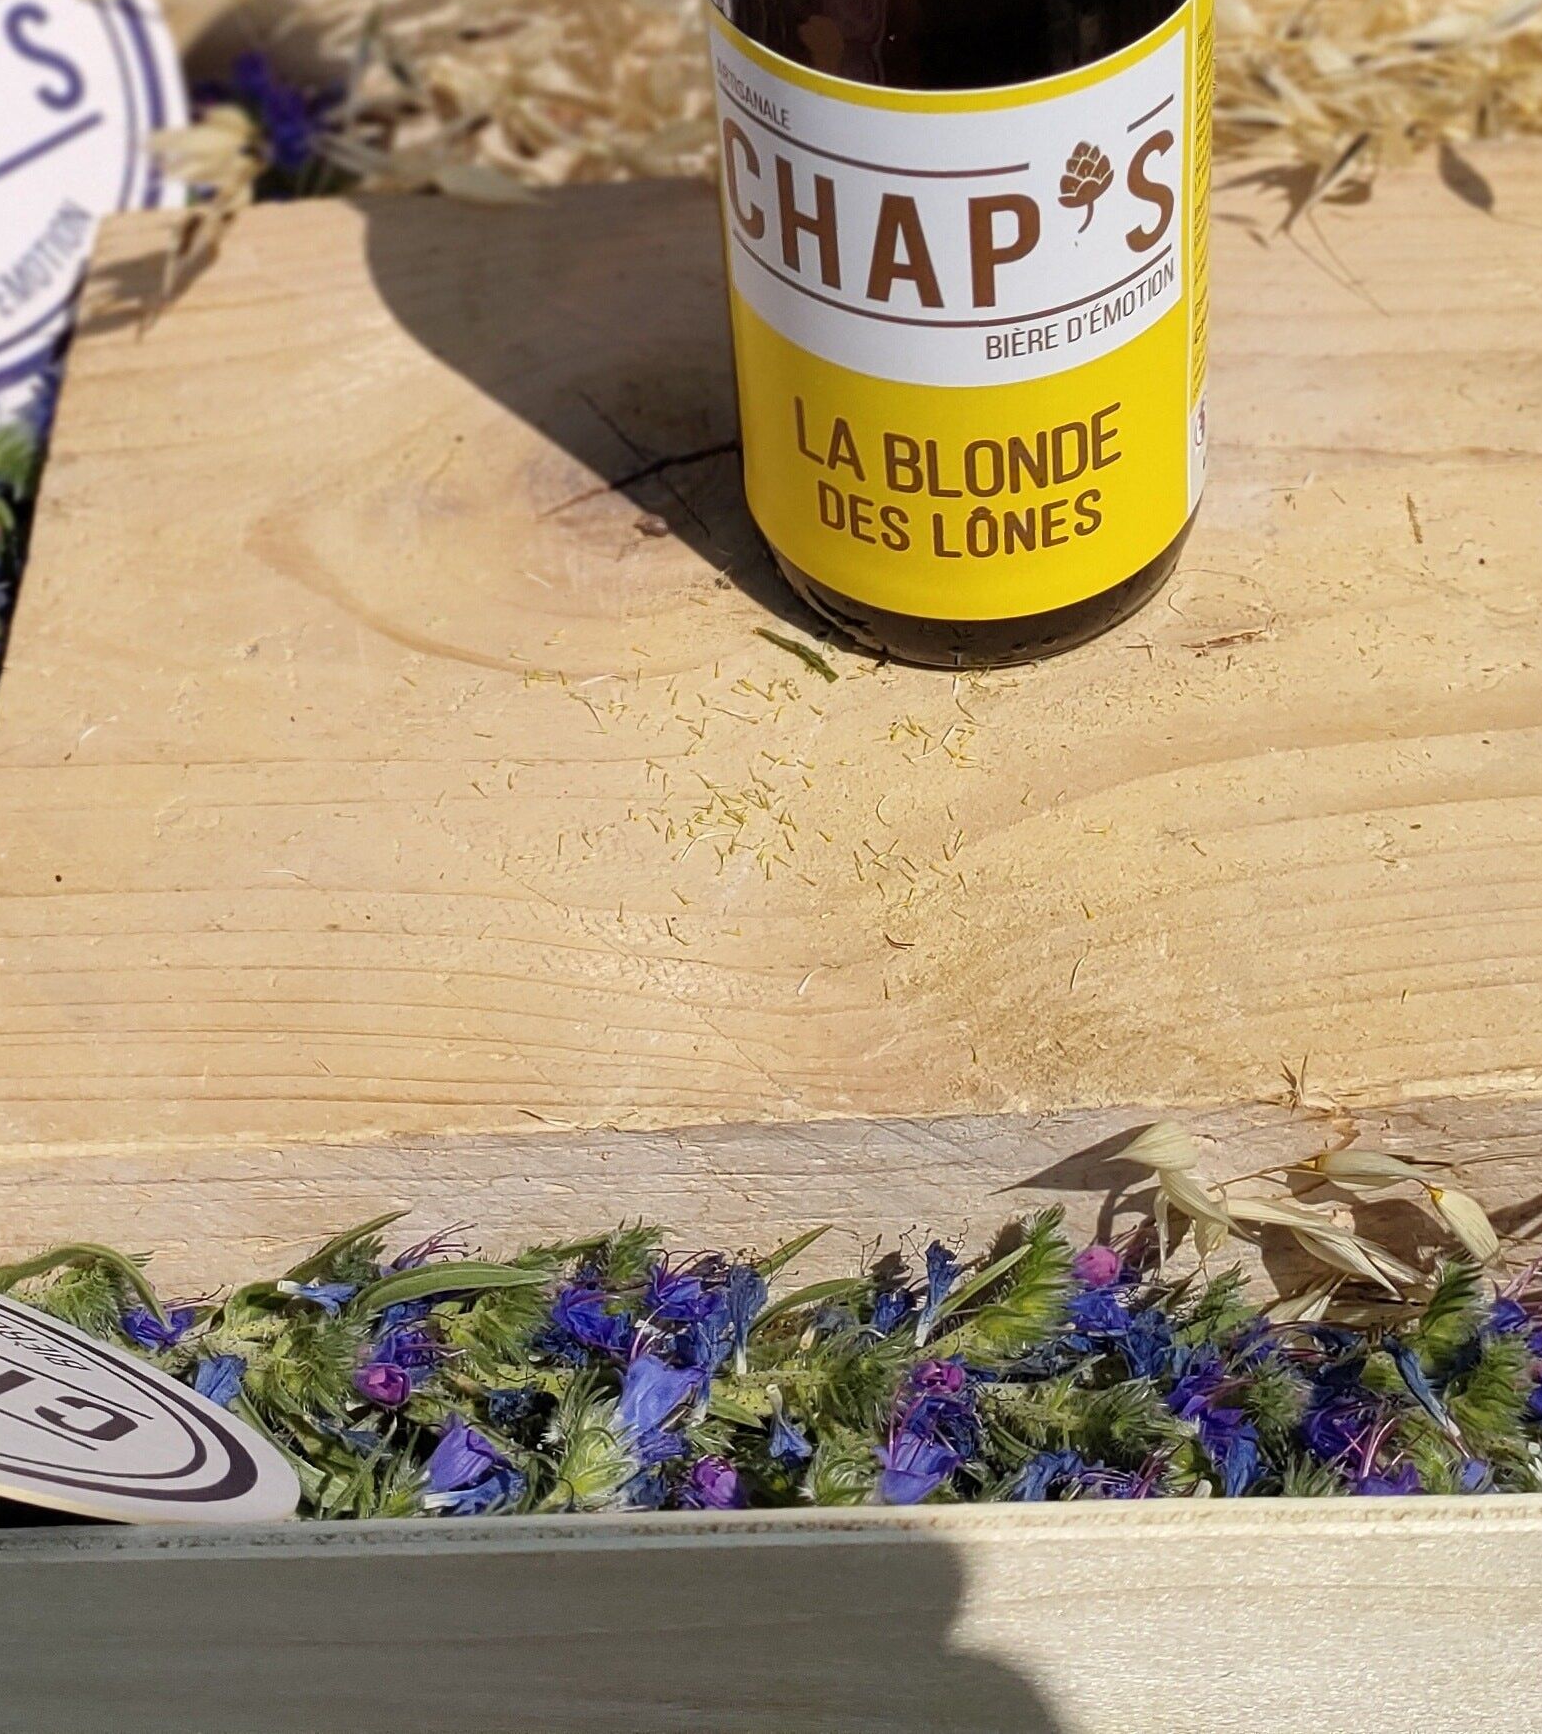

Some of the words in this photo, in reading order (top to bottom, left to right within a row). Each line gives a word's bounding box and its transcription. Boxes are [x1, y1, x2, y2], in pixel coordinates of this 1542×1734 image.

[985, 322, 1060, 361] BIÈRE
[1066, 258, 1176, 344] D'ÉMOTION
[793, 396, 866, 483] LA
[882, 401, 1123, 499] BLONDE
[817, 482, 911, 552] DES
[933, 488, 1103, 559] LÔNES
